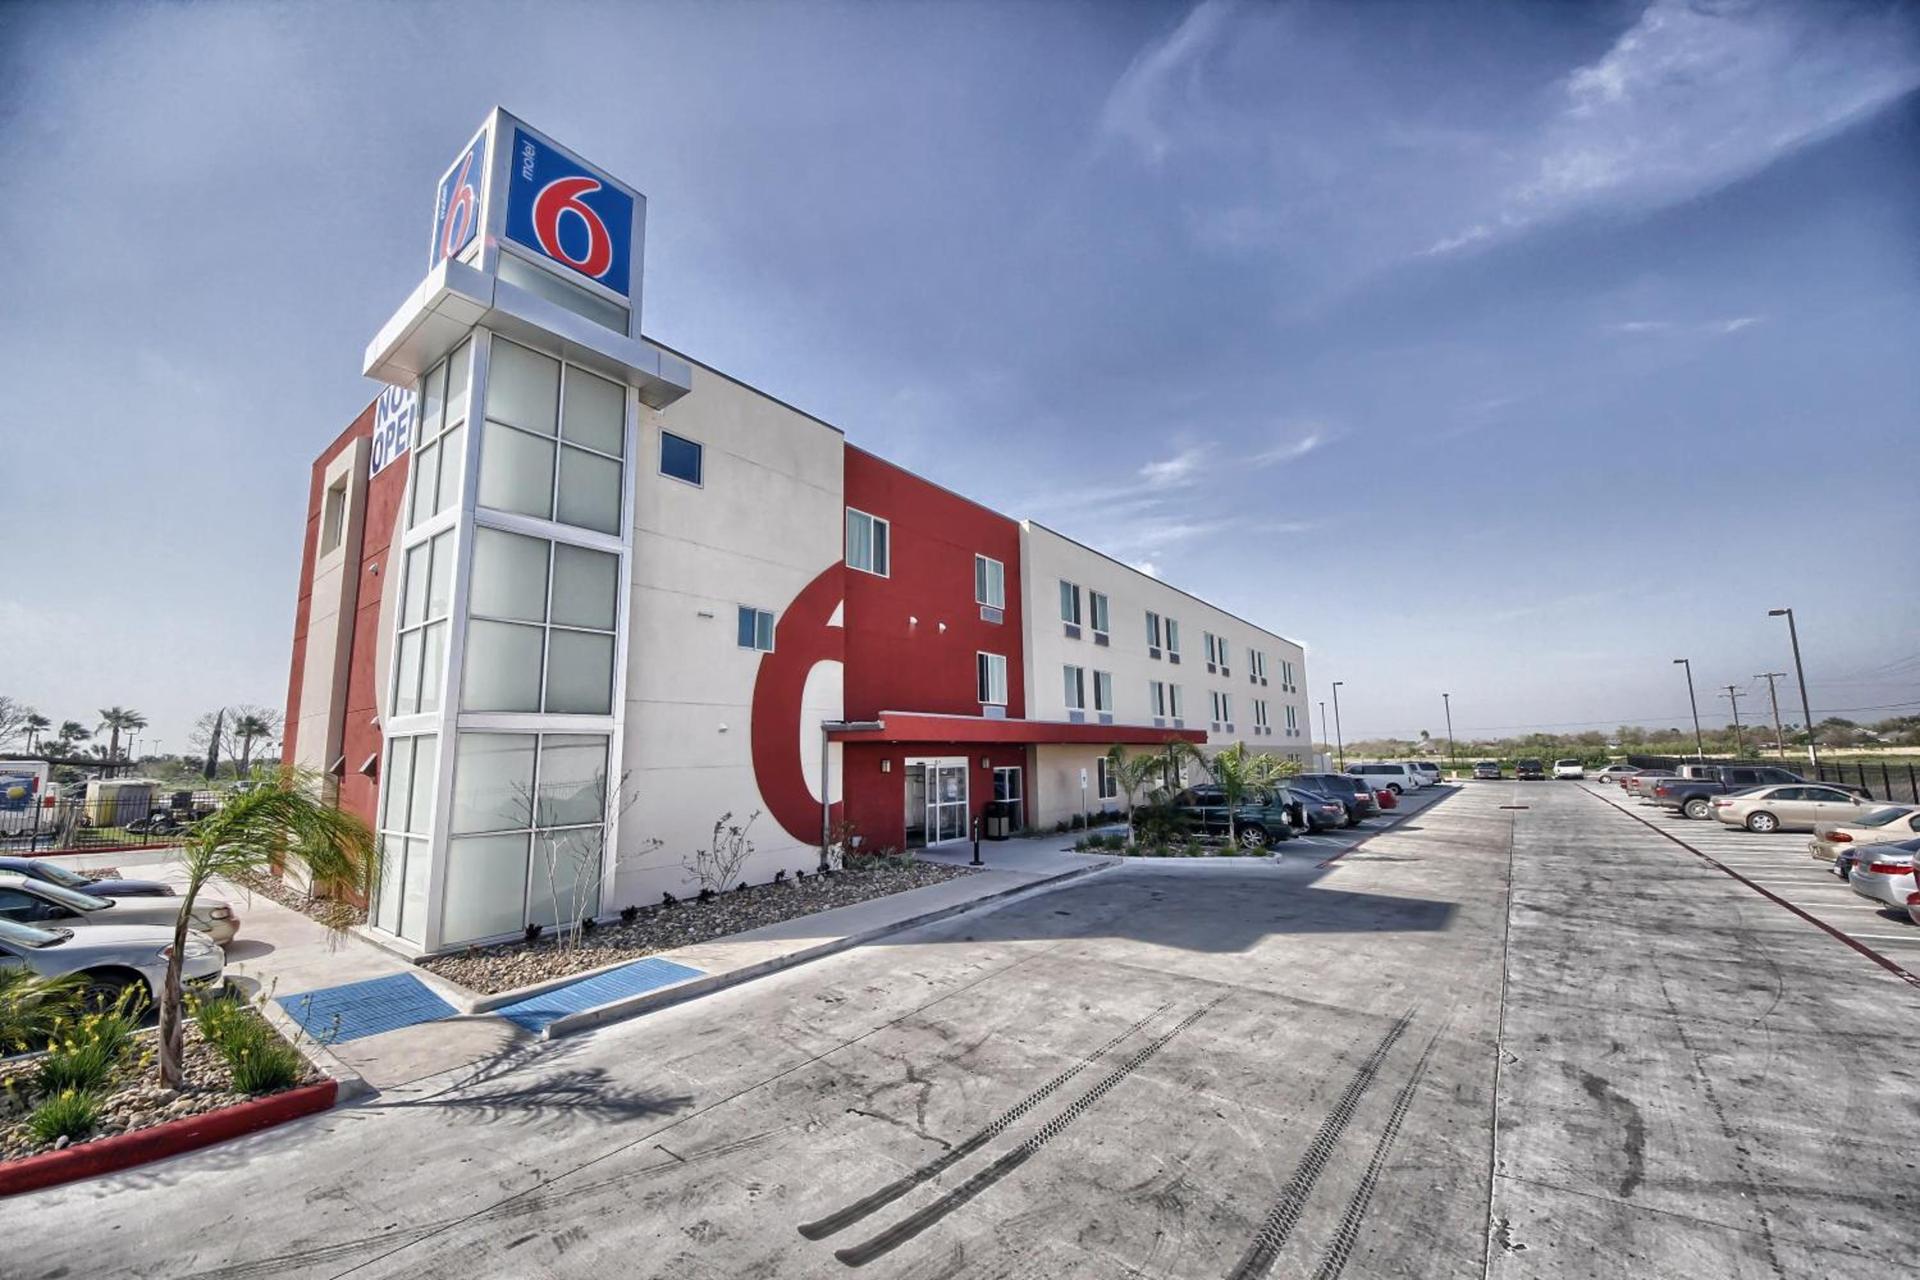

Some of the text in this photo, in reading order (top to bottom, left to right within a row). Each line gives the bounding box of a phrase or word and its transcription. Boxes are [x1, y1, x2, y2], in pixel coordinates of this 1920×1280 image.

[440, 151, 474, 259] 6
[521, 140, 612, 279] motel 6
[377, 386, 412, 429] NO
